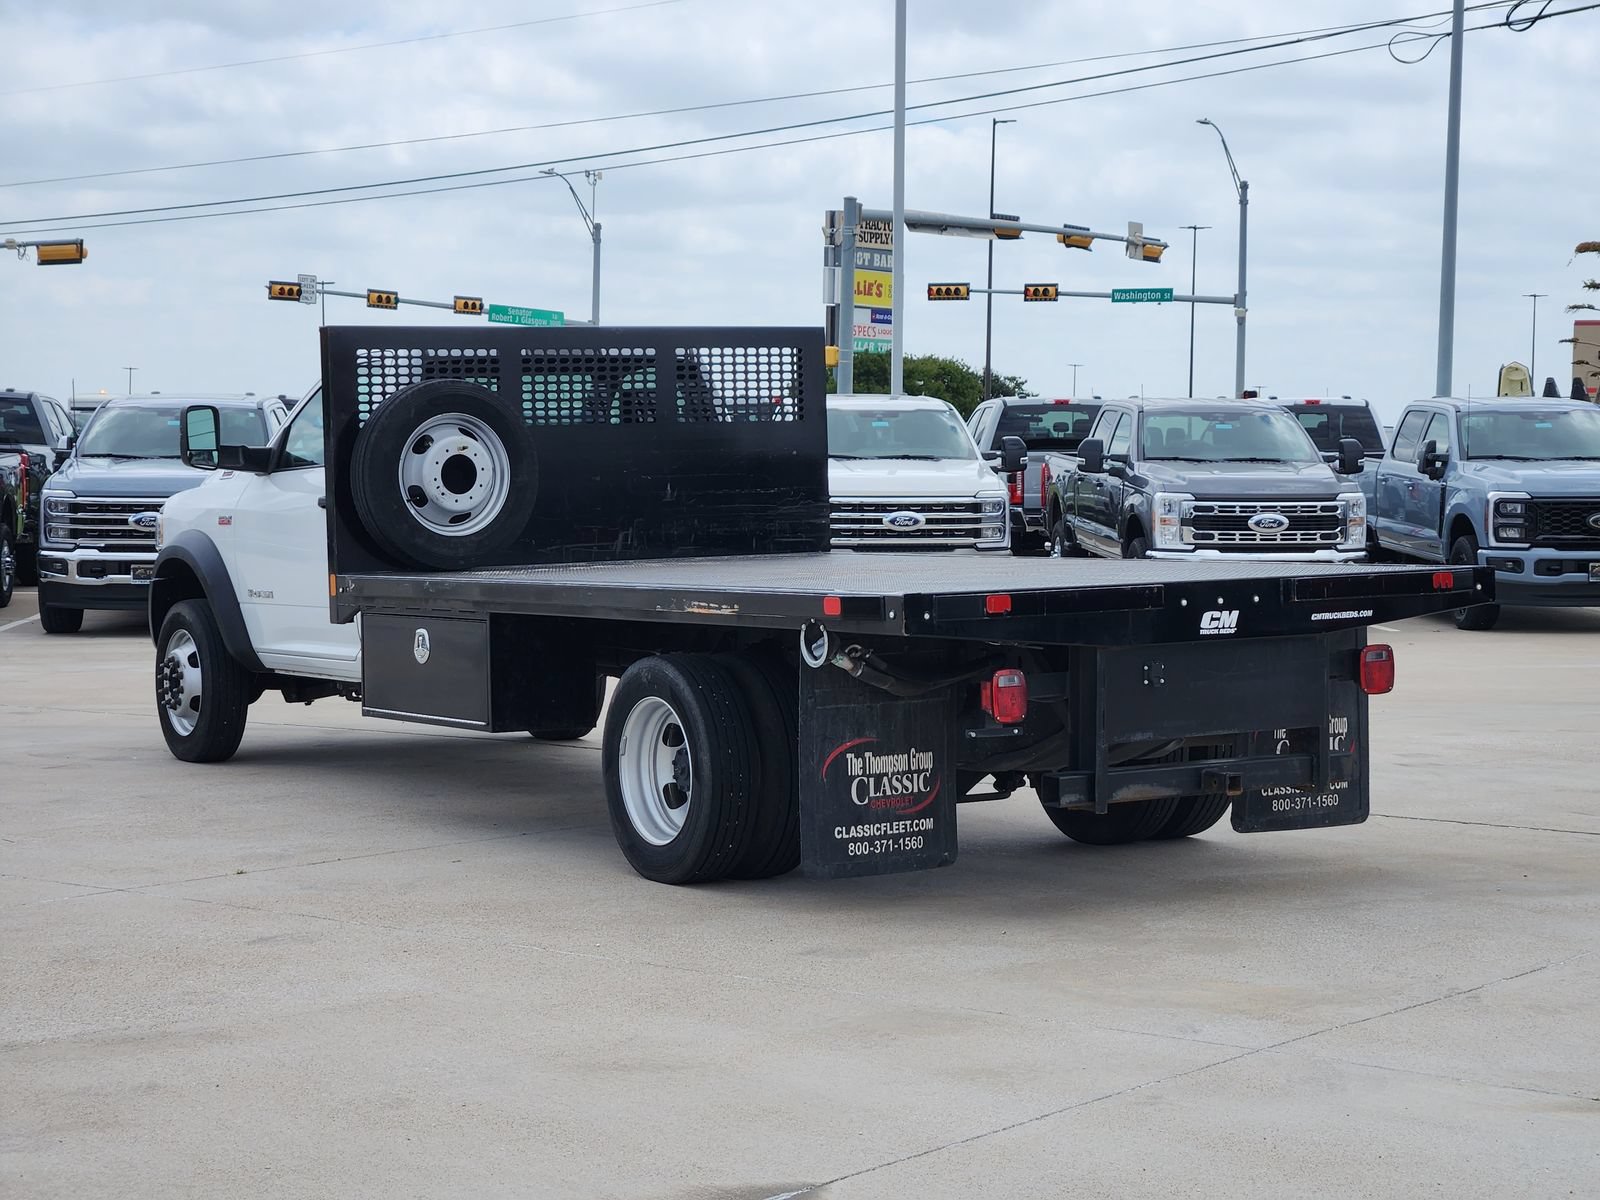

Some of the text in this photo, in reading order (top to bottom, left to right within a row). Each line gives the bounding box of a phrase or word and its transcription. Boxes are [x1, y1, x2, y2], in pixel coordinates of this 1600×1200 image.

[858, 230, 889, 245] SUPPLY
[1114, 291, 1161, 301] Washington
[508, 307, 533, 316] Senator
[492, 313, 513, 323] Robert
[515, 315, 519, 323] J
[521, 315, 548, 327] Glasgow
[894, 516, 915, 526] Ford
[1260, 519, 1280, 528] Ford
[1200, 610, 1239, 628] CM
[1311, 610, 1373, 620] CMTRUCKBEDS.COM
[846, 747, 933, 778] The Thompson Group
[851, 772, 930, 806] CLASSIC
[870, 796, 914, 809] CHEVROLET
[1272, 794, 1339, 812] 800-371-1560
[834, 818, 934, 839] CLASSICFLEET.COM
[848, 835, 924, 856] 800-371-1560
